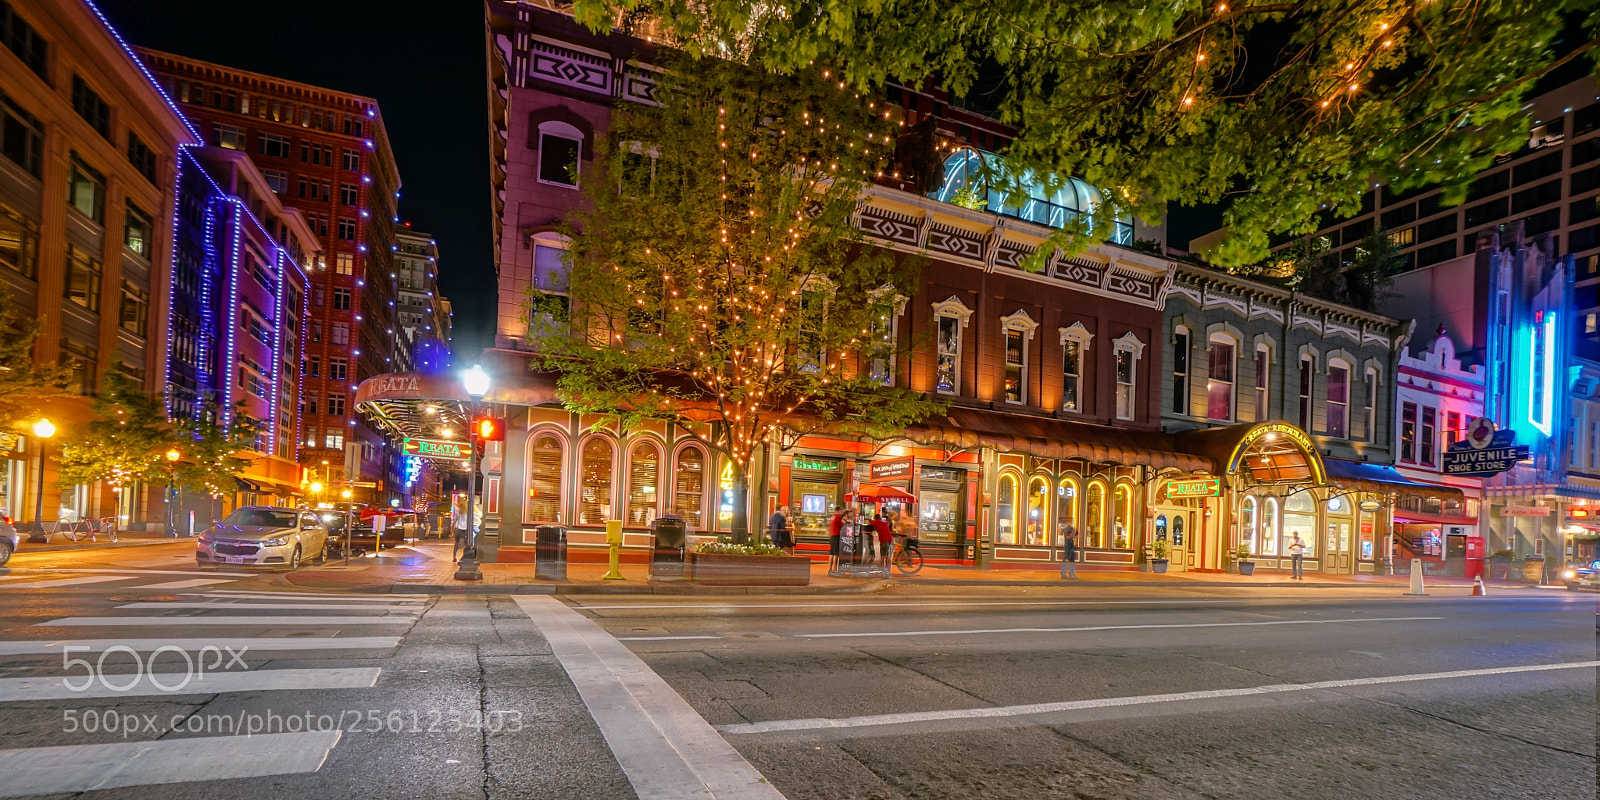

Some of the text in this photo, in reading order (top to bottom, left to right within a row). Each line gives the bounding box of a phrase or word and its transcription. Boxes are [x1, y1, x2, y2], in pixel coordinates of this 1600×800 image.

[368, 377, 419, 396] REATA
[418, 441, 460, 454] REATA
[1452, 449, 1517, 463] JUVENILE
[1448, 460, 1506, 472] SHOE STORE
[1177, 482, 1208, 494] REATA
